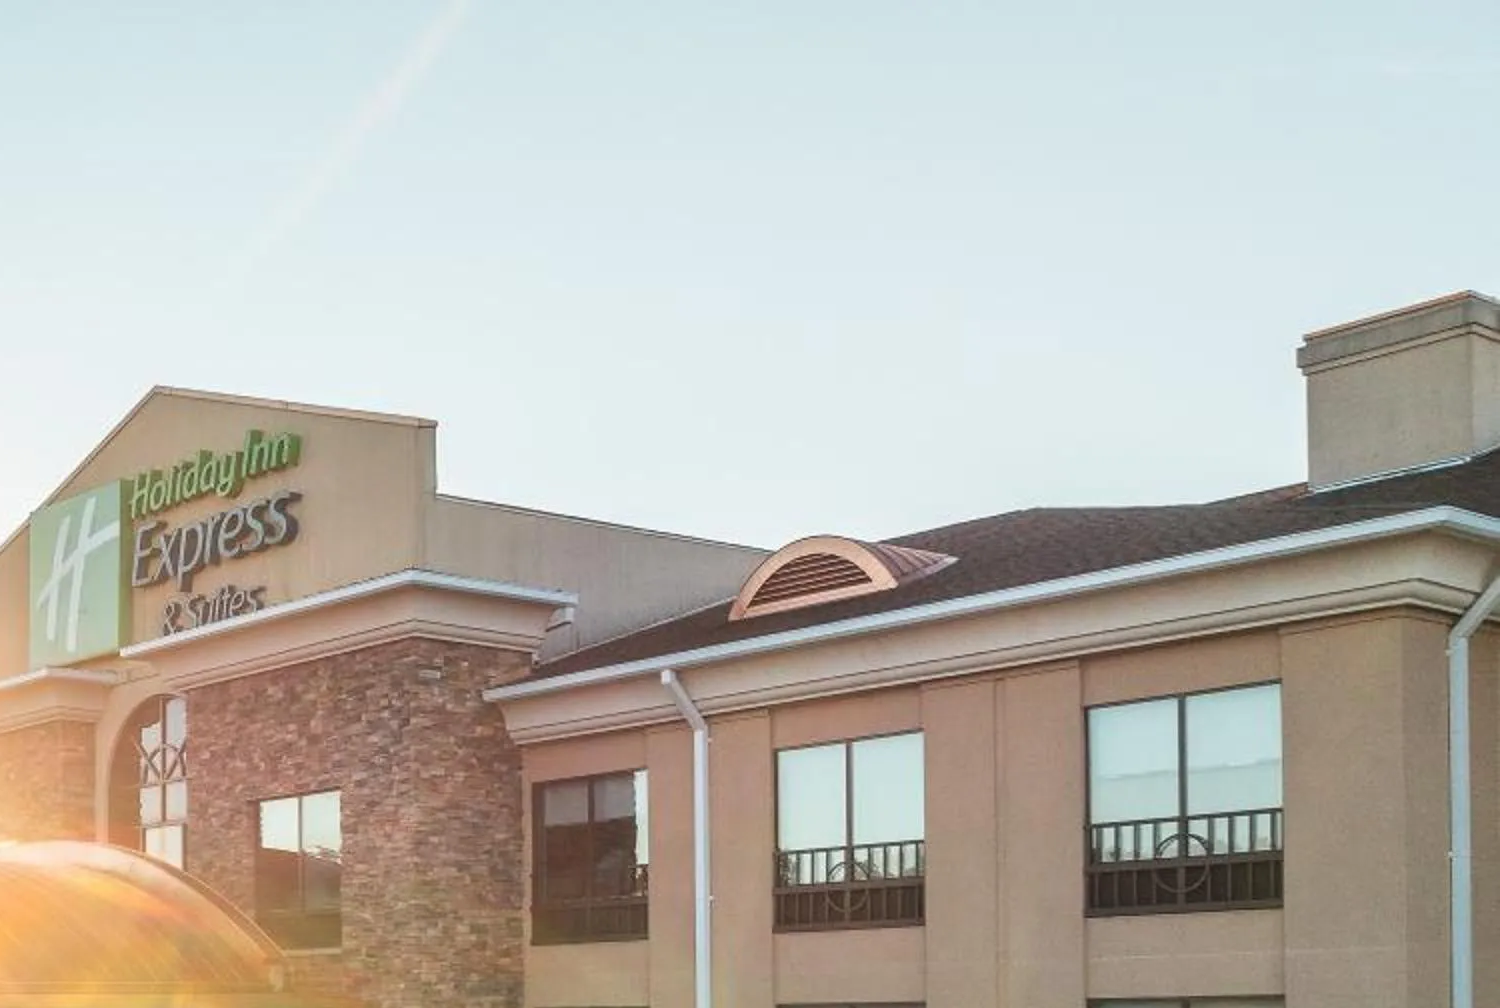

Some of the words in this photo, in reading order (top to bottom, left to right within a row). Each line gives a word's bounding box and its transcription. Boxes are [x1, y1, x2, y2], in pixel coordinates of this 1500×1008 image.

[130, 451, 243, 518] Holiday
[242, 430, 301, 478] Inn
[131, 491, 302, 591] Express
[162, 600, 183, 636] &
[185, 586, 266, 628] Suites
